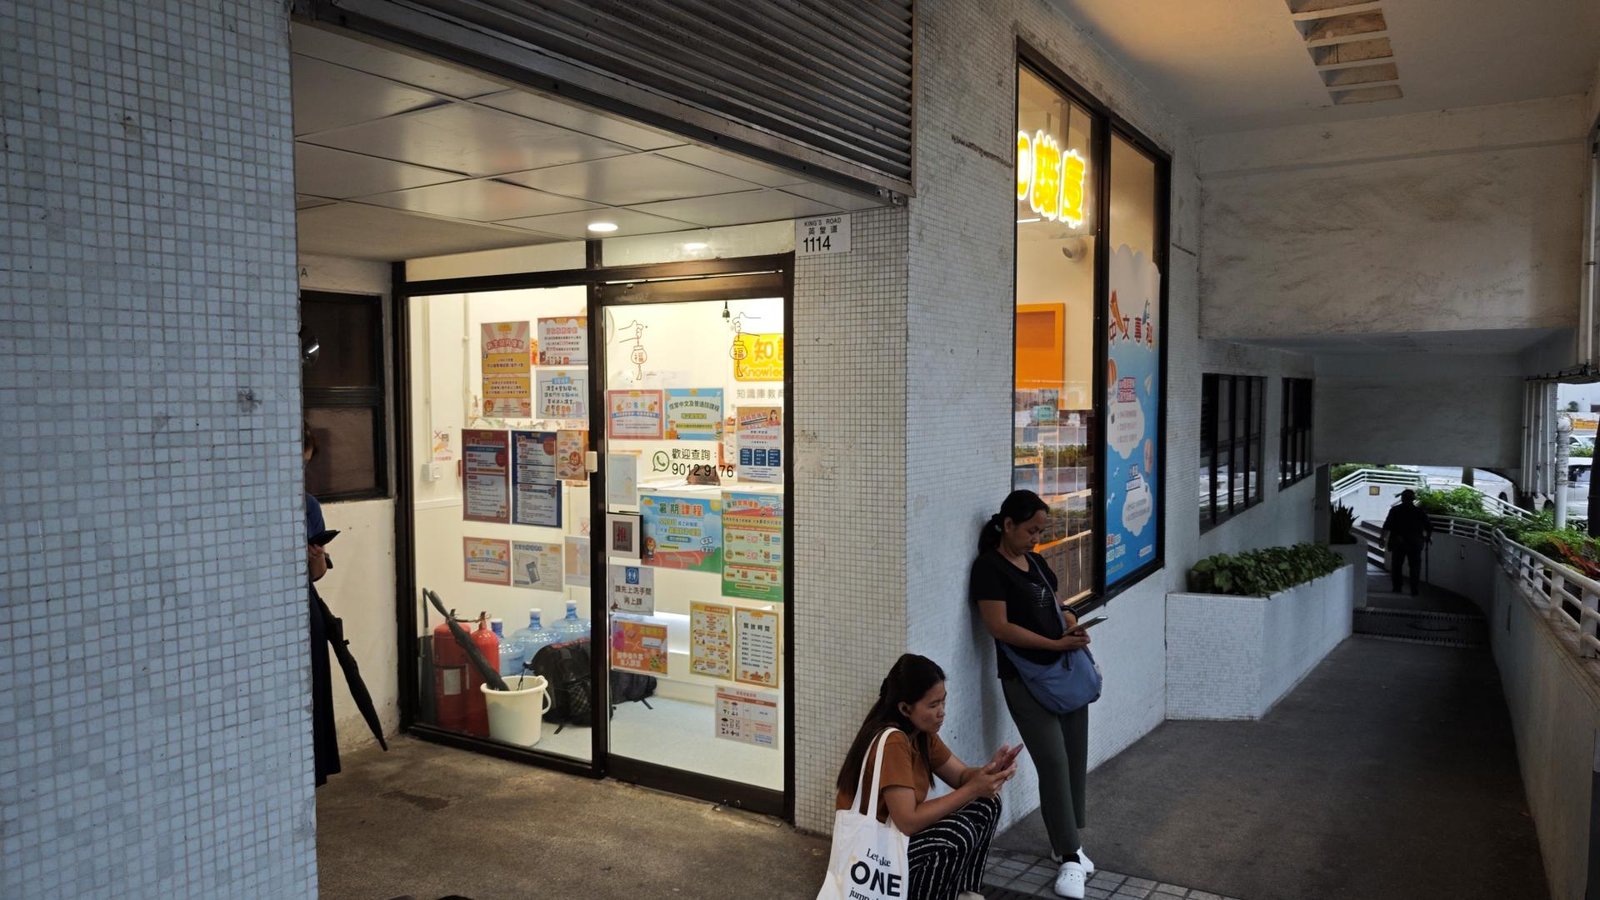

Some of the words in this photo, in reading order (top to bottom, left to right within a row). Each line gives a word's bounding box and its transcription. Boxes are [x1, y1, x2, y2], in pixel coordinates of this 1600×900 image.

[809, 226, 838, 235] 英皇道
[803, 235, 831, 253] 1114
[300, 267, 309, 277] A
[671, 462, 700, 477] 9012
[704, 464, 734, 478] 9176
[850, 860, 902, 897] ONE
